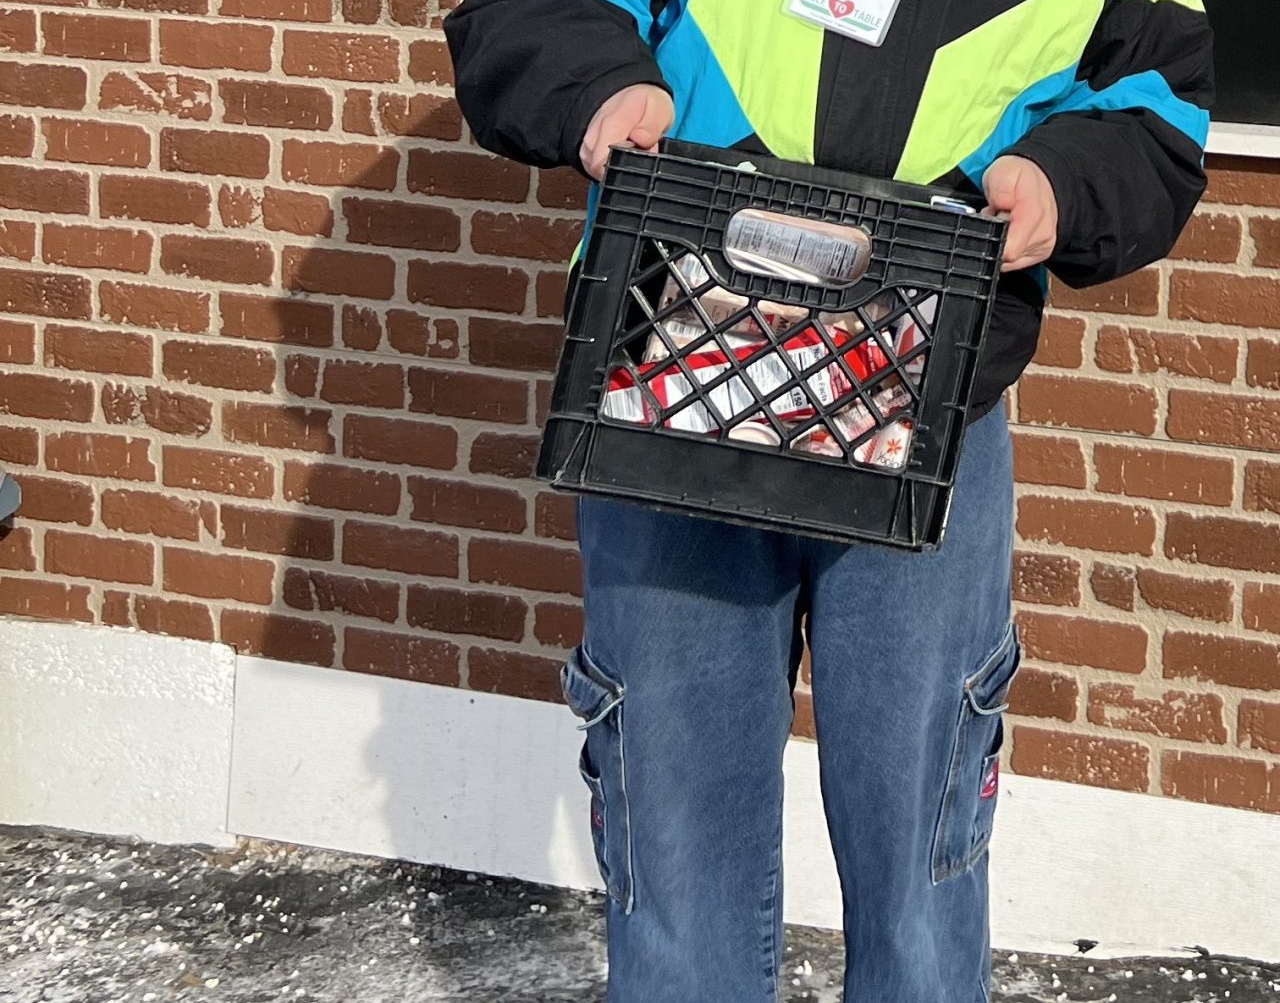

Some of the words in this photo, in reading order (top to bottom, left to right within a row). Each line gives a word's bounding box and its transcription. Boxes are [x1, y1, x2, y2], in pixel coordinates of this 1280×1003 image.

[833, 1, 847, 14] TO
[854, 9, 882, 27] TABLE
[793, 392, 803, 407] 150
